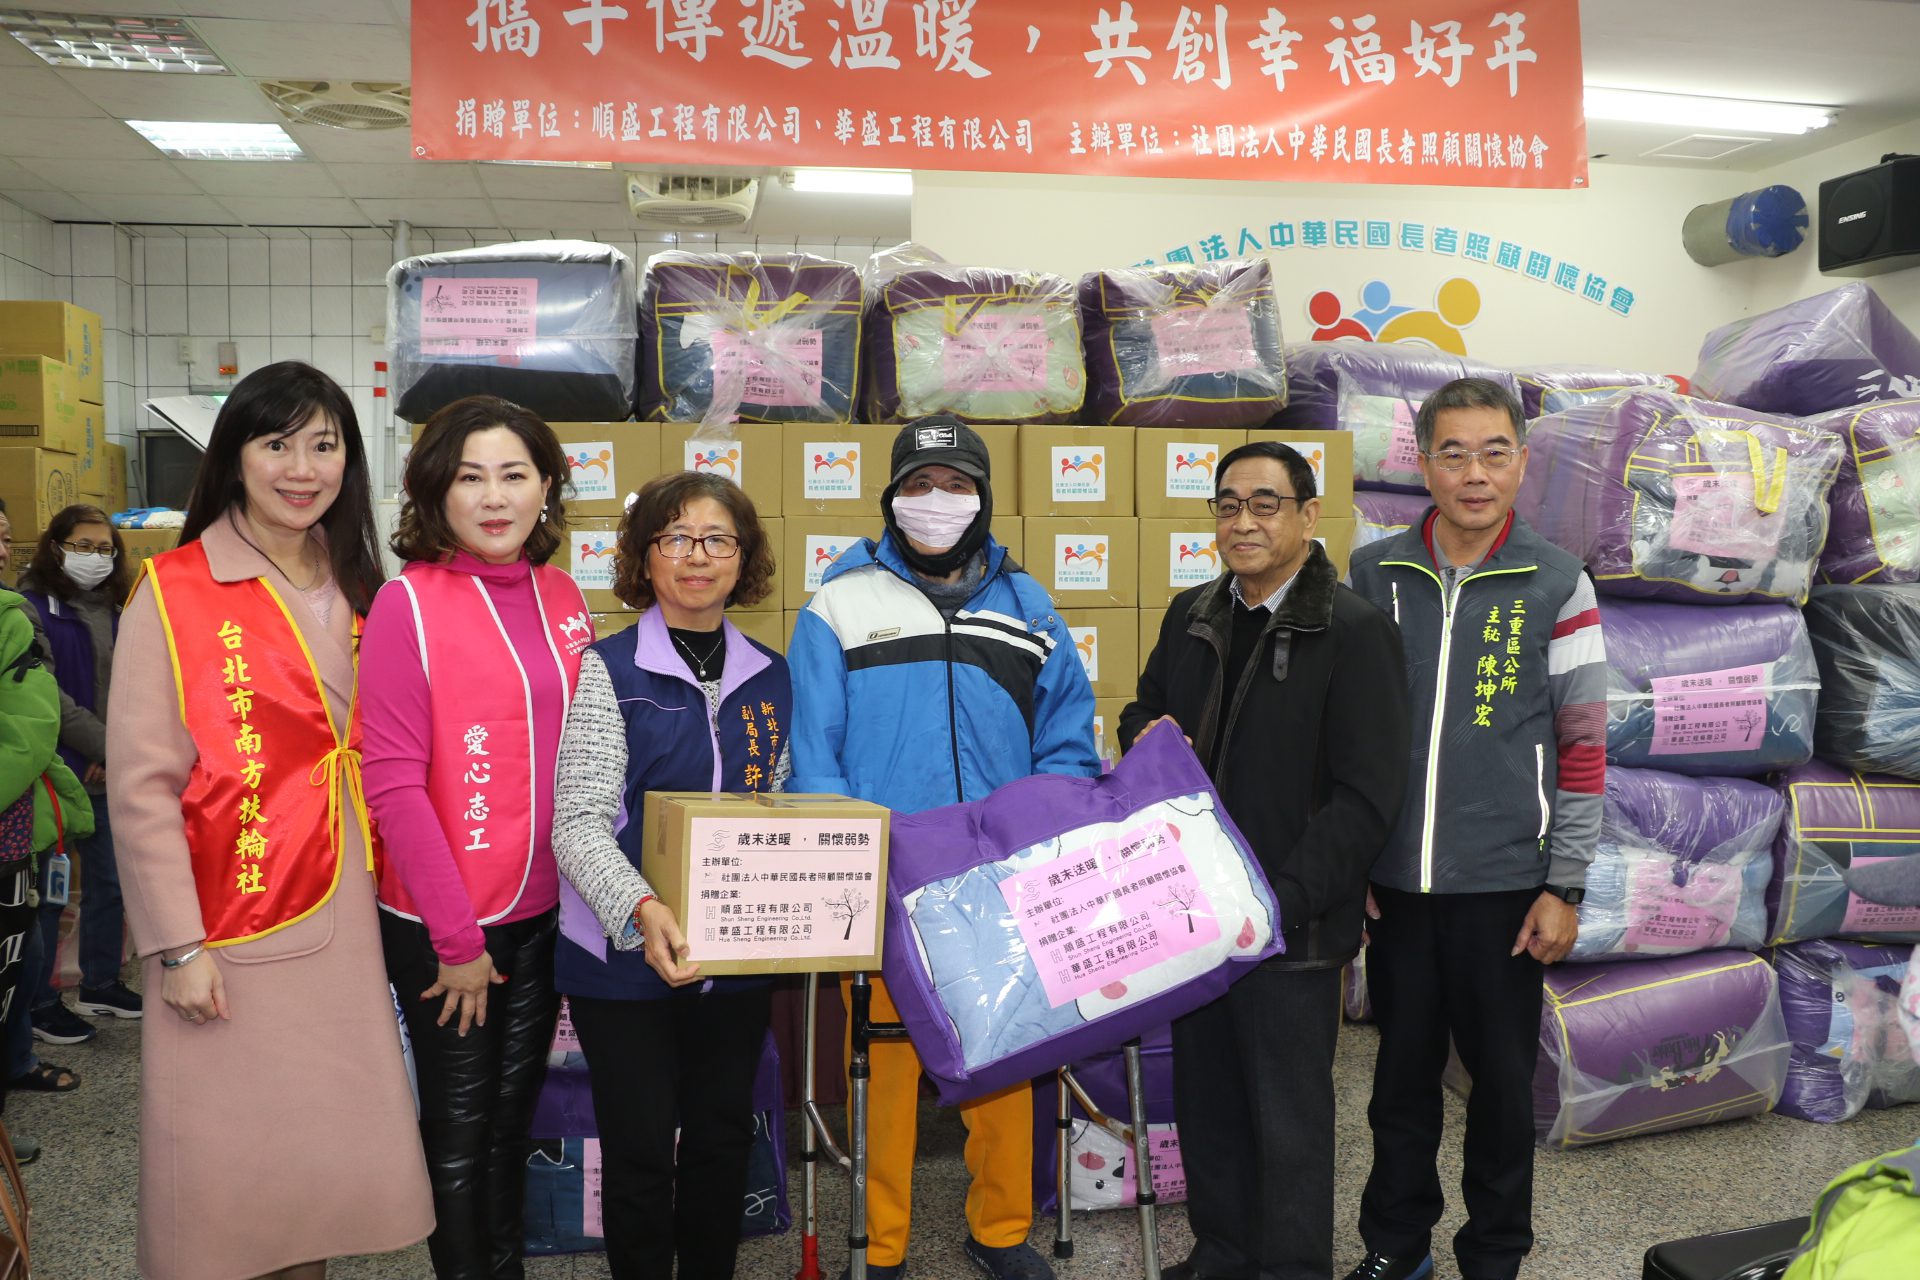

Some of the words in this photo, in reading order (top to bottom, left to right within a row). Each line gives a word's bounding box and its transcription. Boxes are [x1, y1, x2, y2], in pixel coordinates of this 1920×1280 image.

[1131, 220, 1636, 316] 團法人中華民國長者照顧關懷協會
[1500, 599, 1526, 695] 三重區公所
[1472, 654, 1500, 727] 陳坤宏
[216, 620, 269, 895] 台北市南方扶輪社
[741, 705, 761, 757] 副局長
[463, 725, 491, 851] 愛心志工
[744, 764, 763, 799] 許
[719, 924, 812, 936] 華盛工程有限公司
[721, 903, 812, 914] 順盛工程有限公司
[1071, 930, 1158, 974] 華盛工程有限公司
